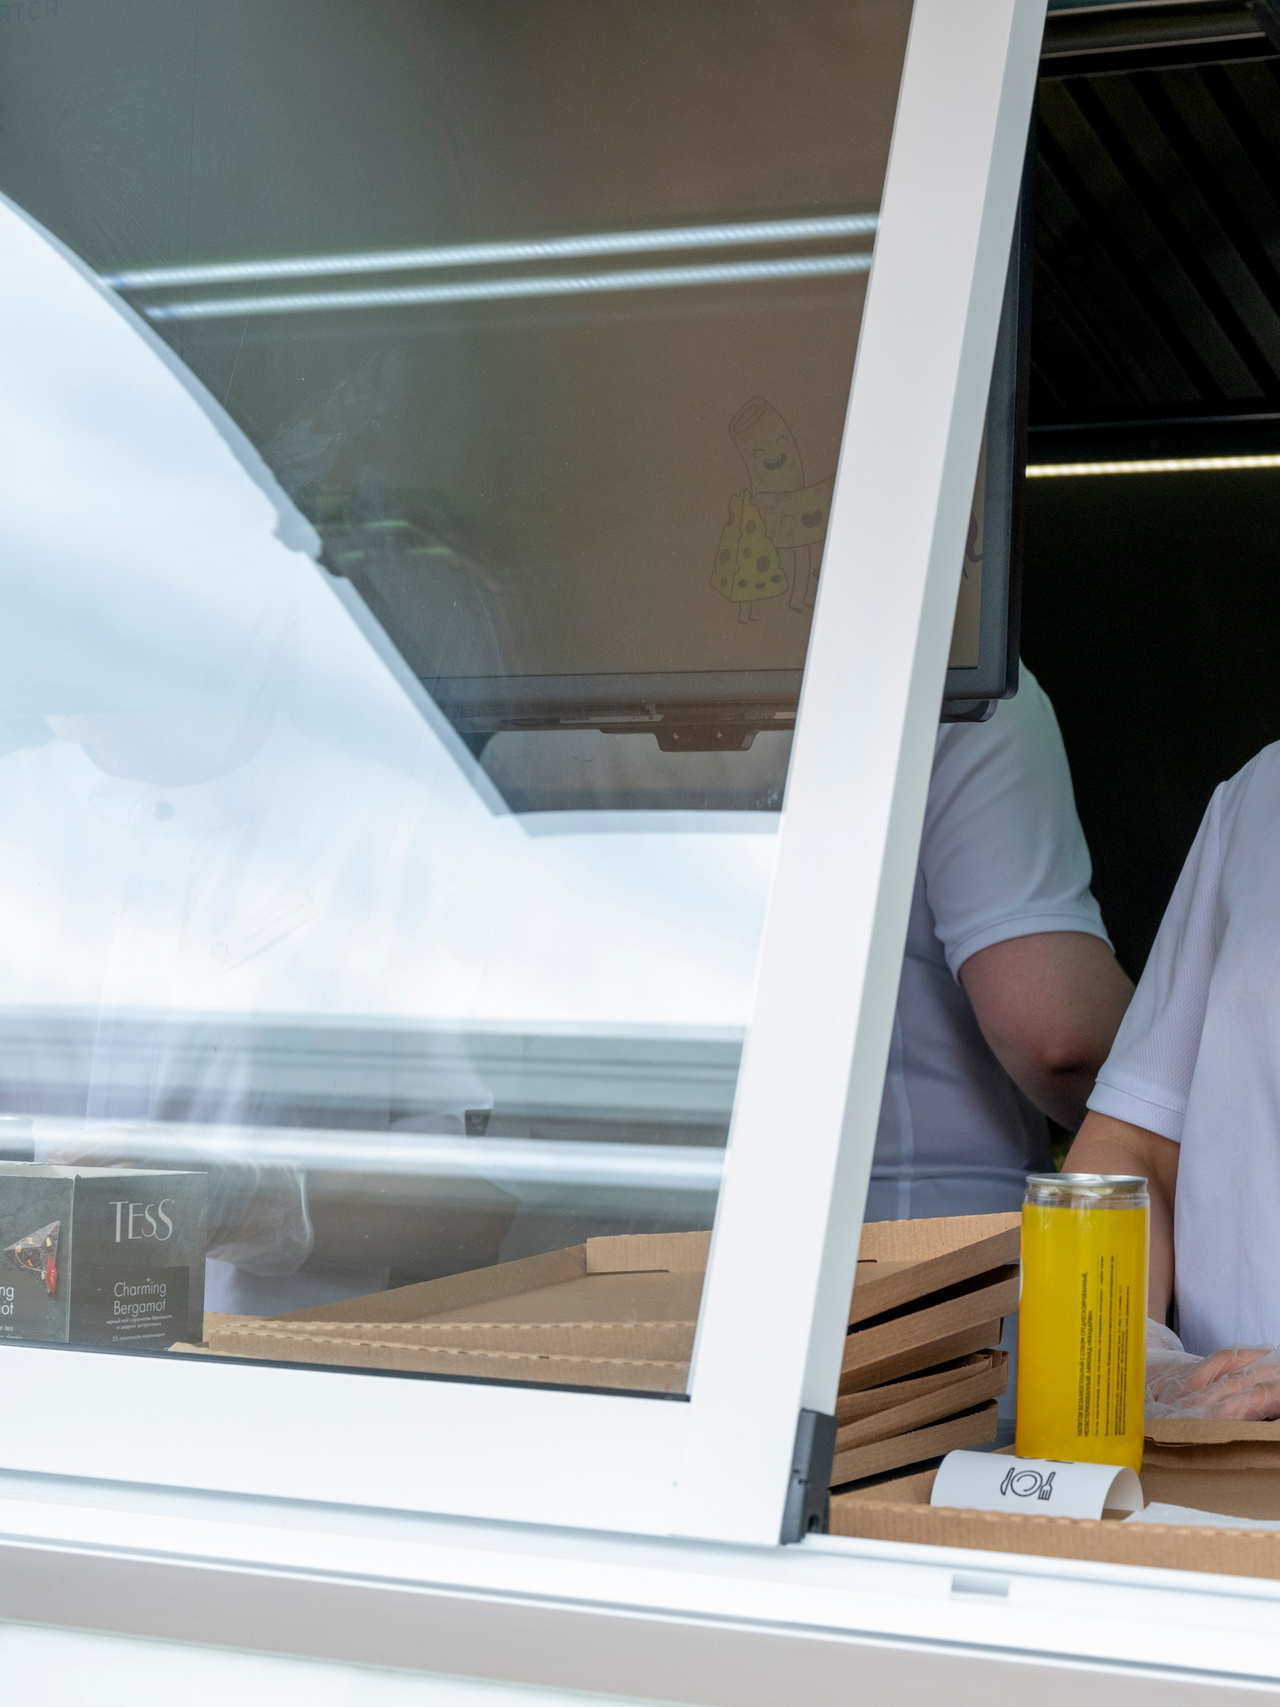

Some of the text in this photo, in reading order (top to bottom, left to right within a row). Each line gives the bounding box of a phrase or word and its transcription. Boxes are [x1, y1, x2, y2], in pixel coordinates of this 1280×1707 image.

[109, 1198, 173, 1243] TESS
[113, 1281, 167, 1298] Charming
[113, 1299, 167, 1318] Bergamot
